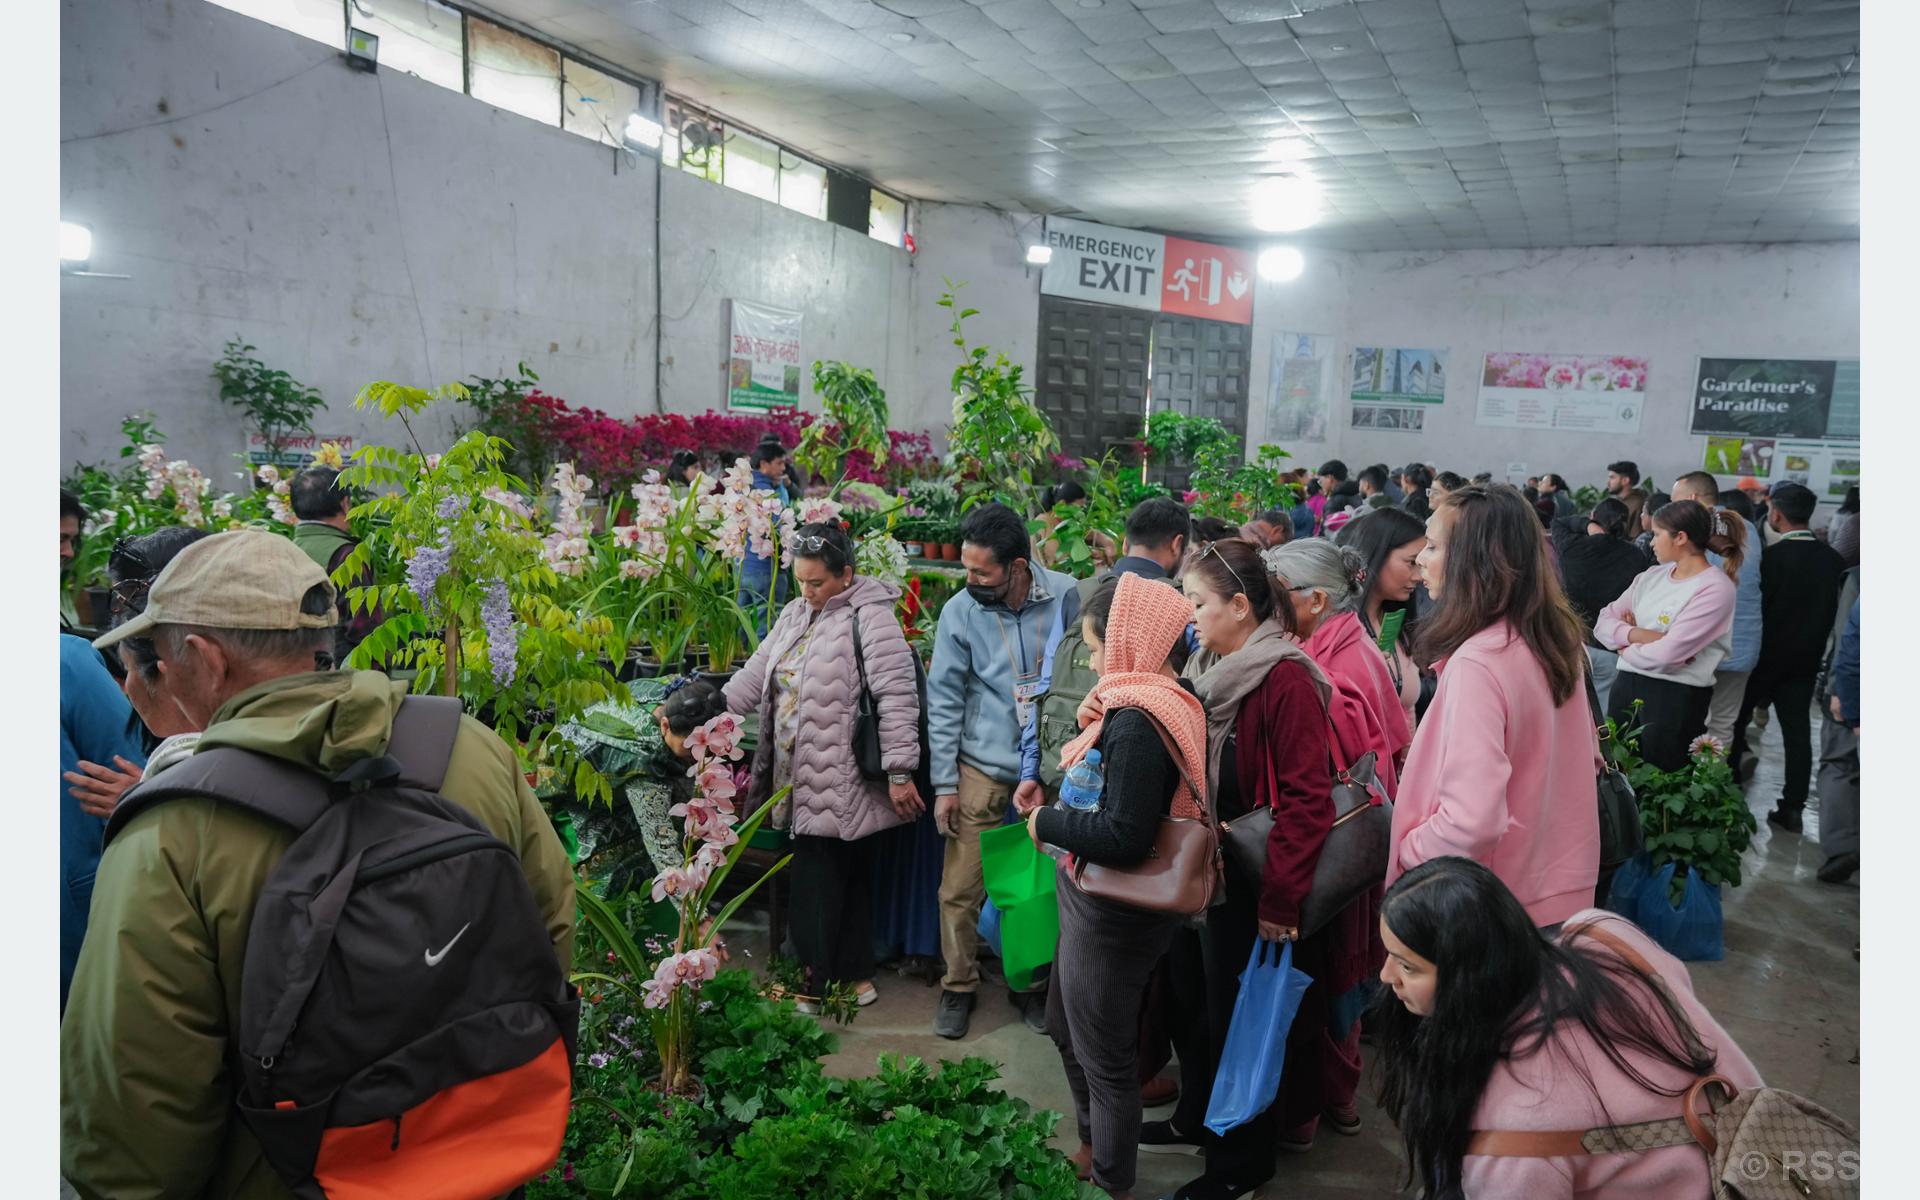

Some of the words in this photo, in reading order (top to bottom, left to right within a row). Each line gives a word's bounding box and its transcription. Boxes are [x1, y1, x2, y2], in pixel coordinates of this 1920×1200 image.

[1049, 231, 1156, 263] EMERGENCY
[1079, 257, 1155, 296] EXIT
[1701, 377, 1817, 395] Gardener's
[1698, 396, 1790, 414] Paradise
